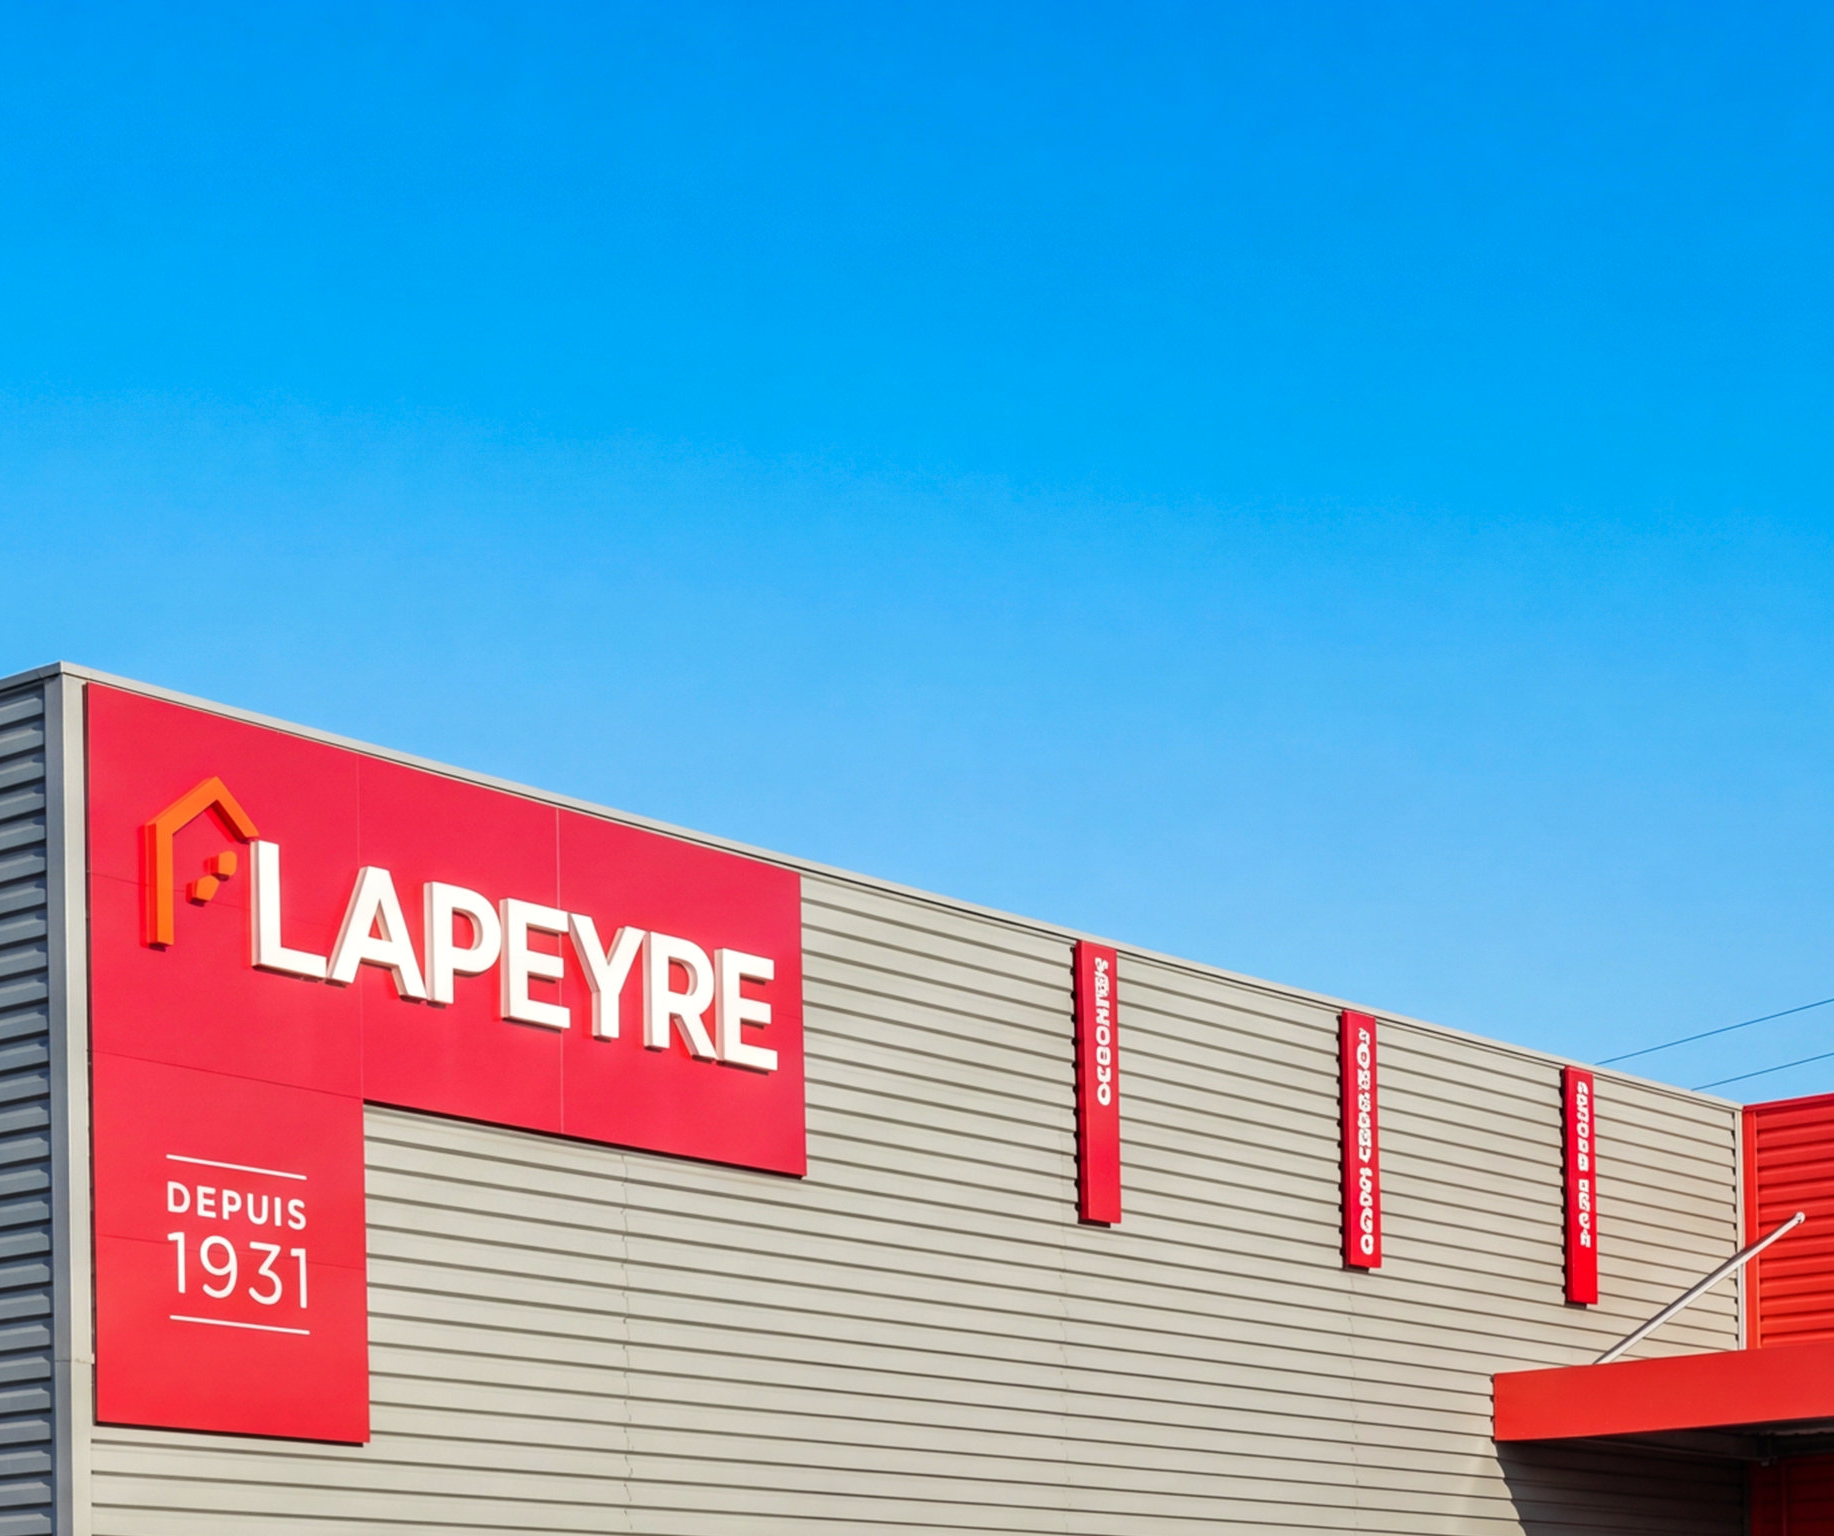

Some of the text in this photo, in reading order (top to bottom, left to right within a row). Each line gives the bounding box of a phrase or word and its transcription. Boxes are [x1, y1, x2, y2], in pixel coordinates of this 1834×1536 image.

[250, 838, 779, 1073] LAPEYRE
[166, 1181, 307, 1229] DEPUIS
[167, 1231, 308, 1309] 1931
